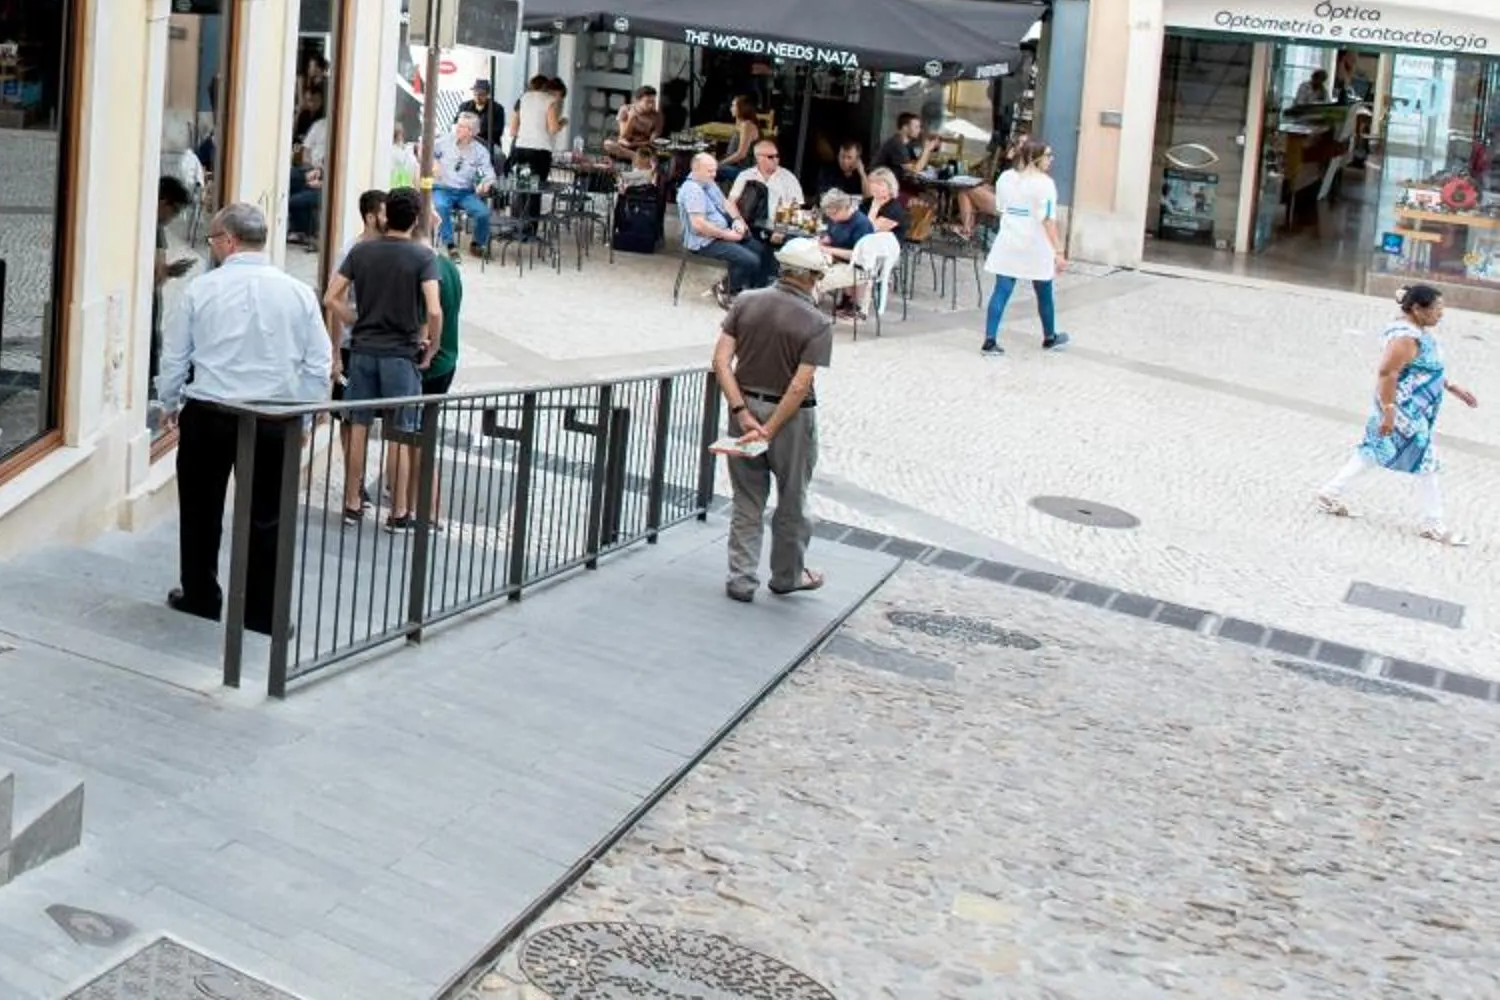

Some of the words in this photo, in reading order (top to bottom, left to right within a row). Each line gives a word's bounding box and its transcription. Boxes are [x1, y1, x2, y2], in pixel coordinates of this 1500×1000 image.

[1313, 0, 1382, 22] Óptica
[684, 29, 709, 45] THE
[713, 33, 764, 53] WORLD
[767, 41, 814, 61] NEEDS
[817, 48, 860, 68] NATA
[1214, 11, 1324, 37] Optometria
[1330, 24, 1344, 37] e
[1349, 25, 1488, 51] contactologia
